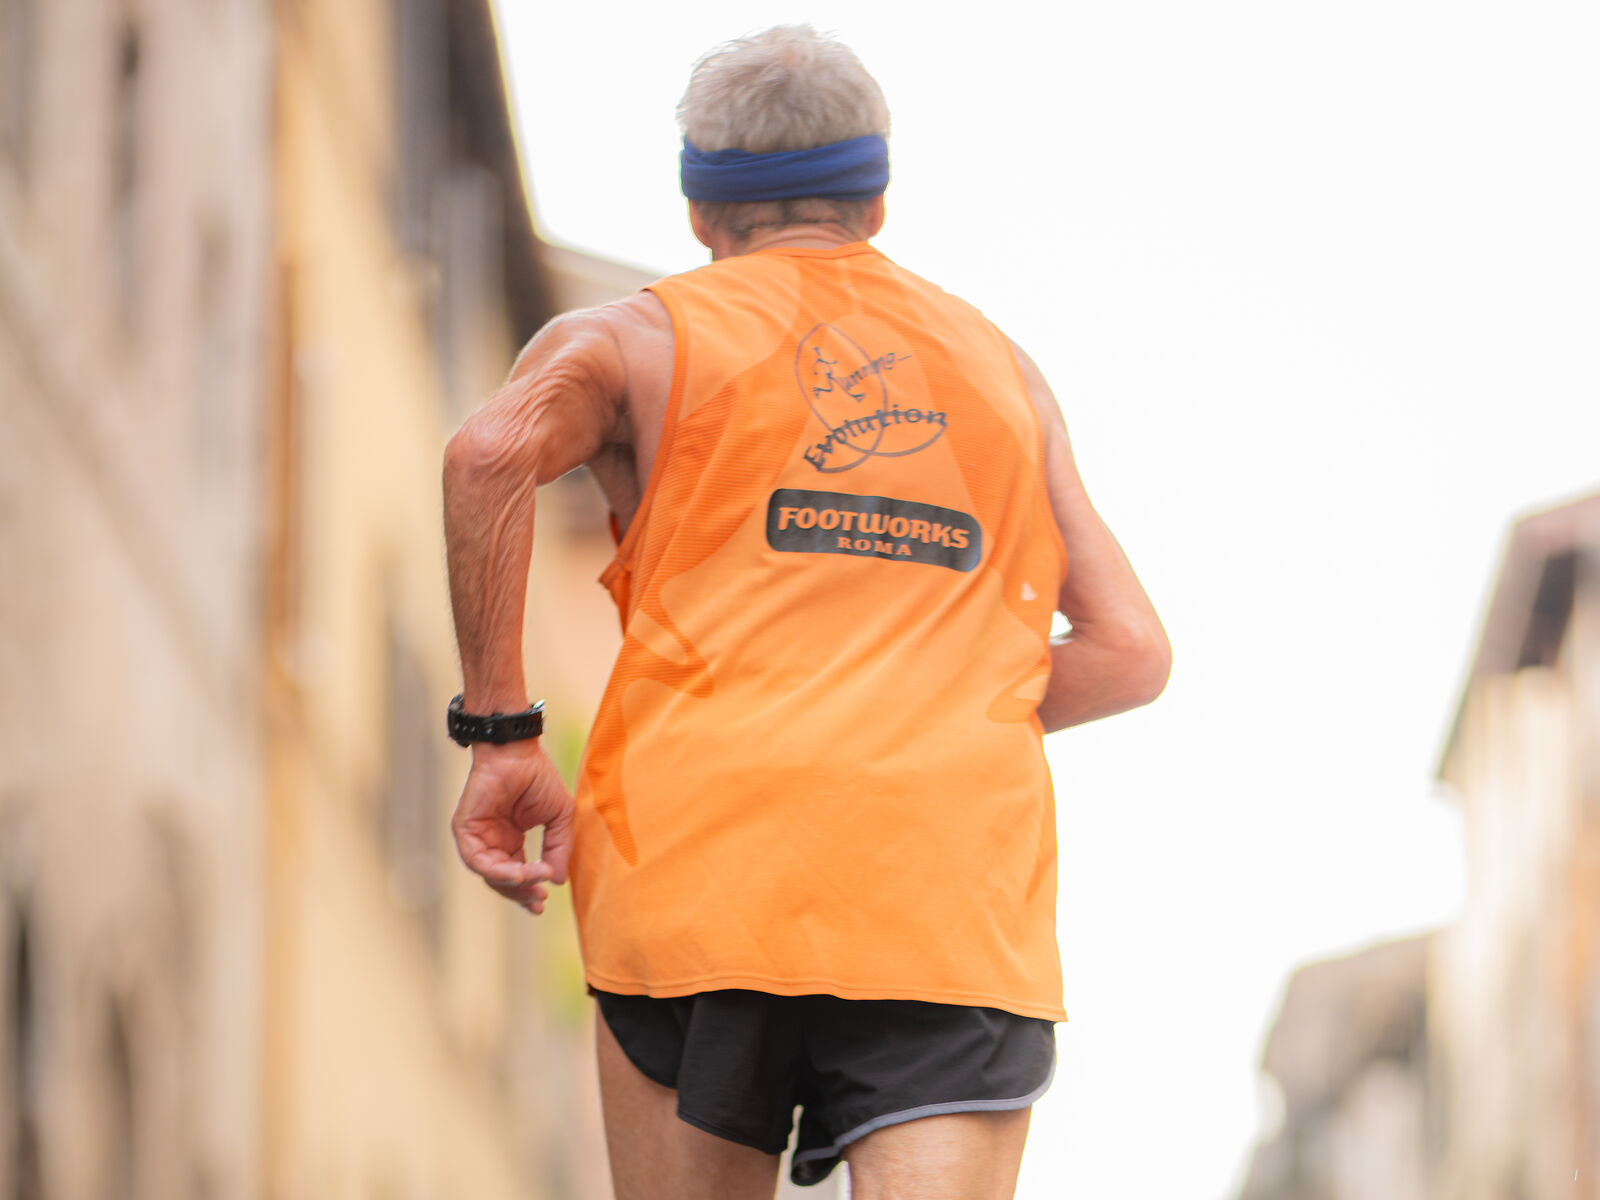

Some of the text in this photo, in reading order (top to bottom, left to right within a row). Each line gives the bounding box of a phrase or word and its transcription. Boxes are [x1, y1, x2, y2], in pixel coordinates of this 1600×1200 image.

[803, 404, 947, 471] Evolution
[777, 506, 970, 549] FOOTWORKS
[836, 536, 912, 556] ROMA
